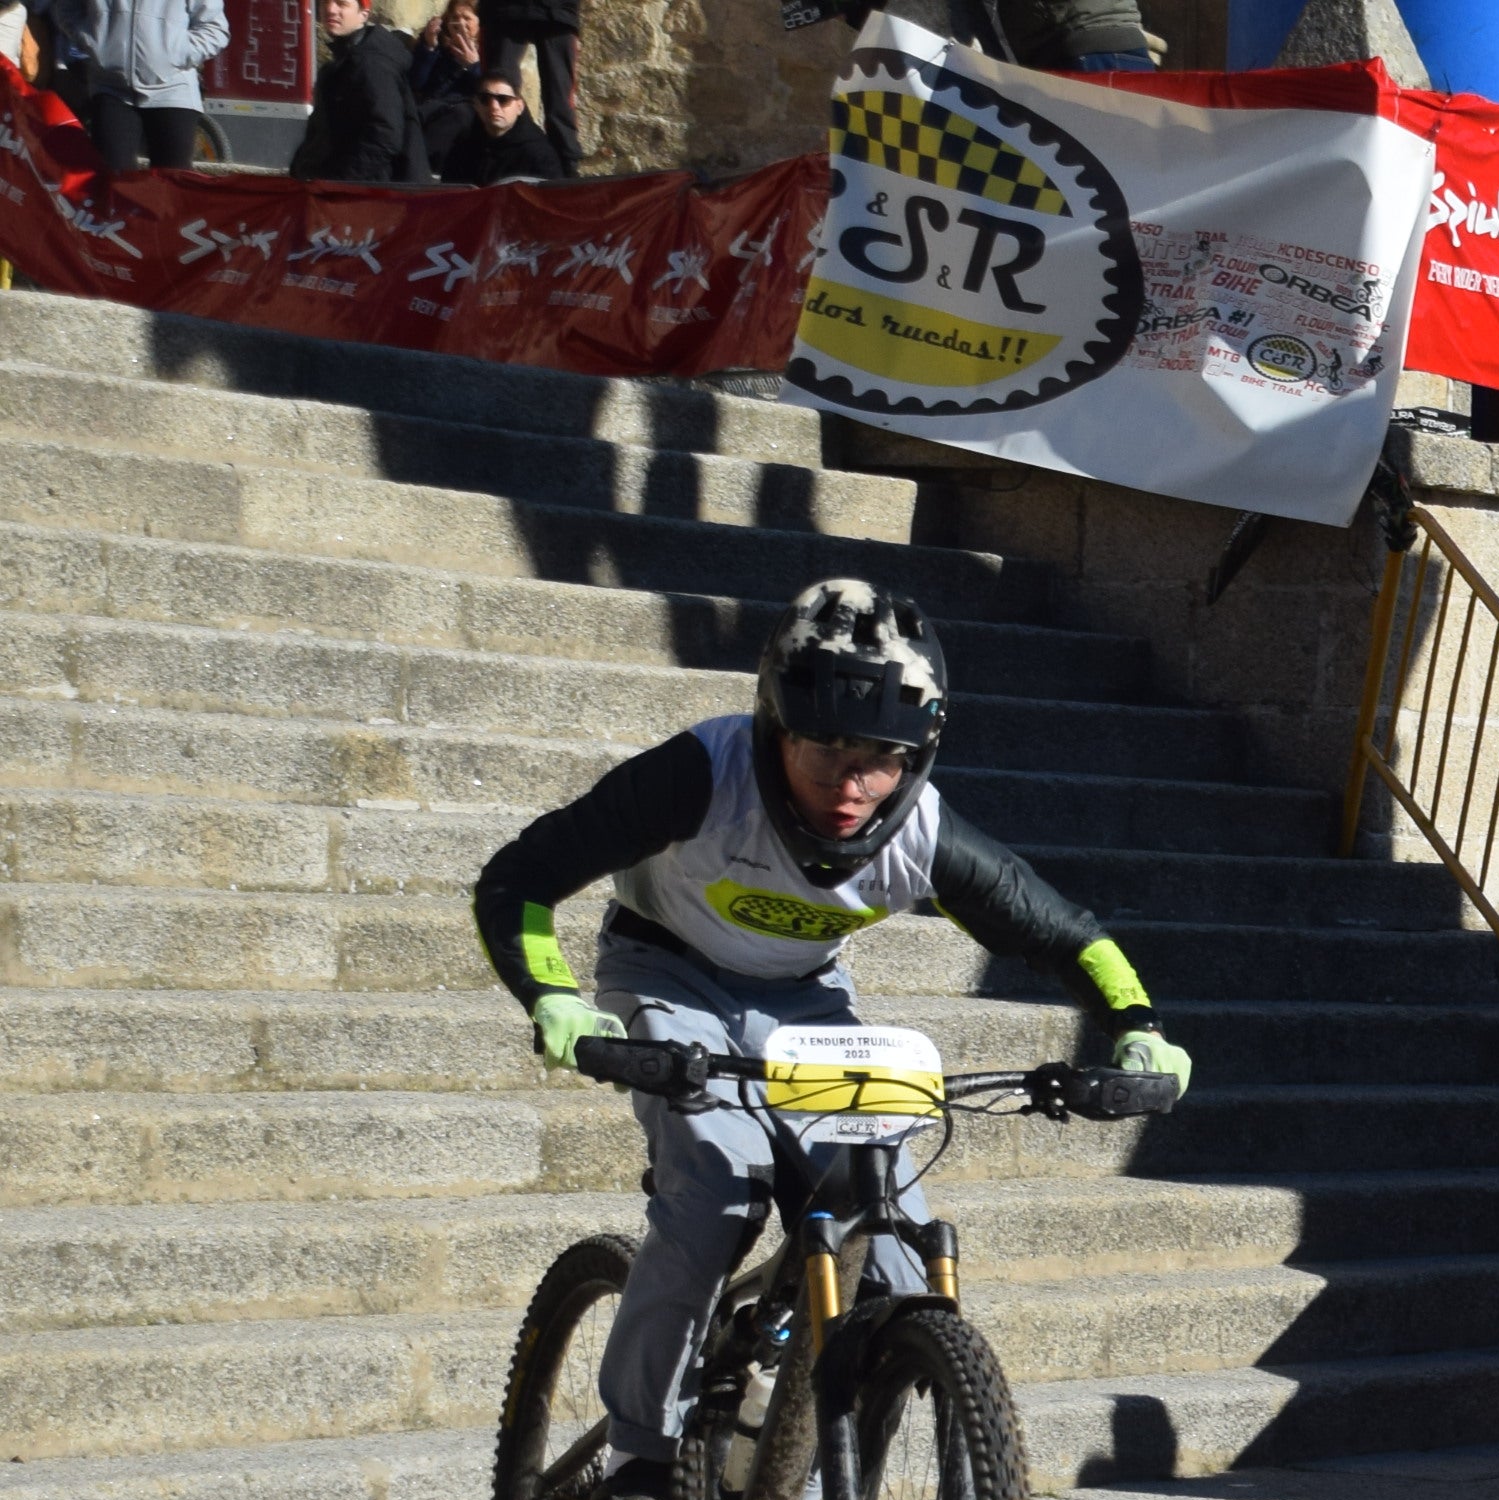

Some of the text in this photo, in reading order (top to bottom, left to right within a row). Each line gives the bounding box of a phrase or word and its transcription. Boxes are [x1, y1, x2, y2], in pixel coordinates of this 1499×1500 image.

[1295, 246, 1380, 277] DESCENSO
[1150, 283, 1196, 300] TRAIL
[1211, 271, 1263, 296] BIKE
[1259, 264, 1371, 322] ORBEA
[1208, 346, 1241, 363] MTB
[810, 1037, 854, 1047] ENDURO
[857, 1037, 904, 1048] TRUJILLO
[844, 1050, 871, 1059] 2023
